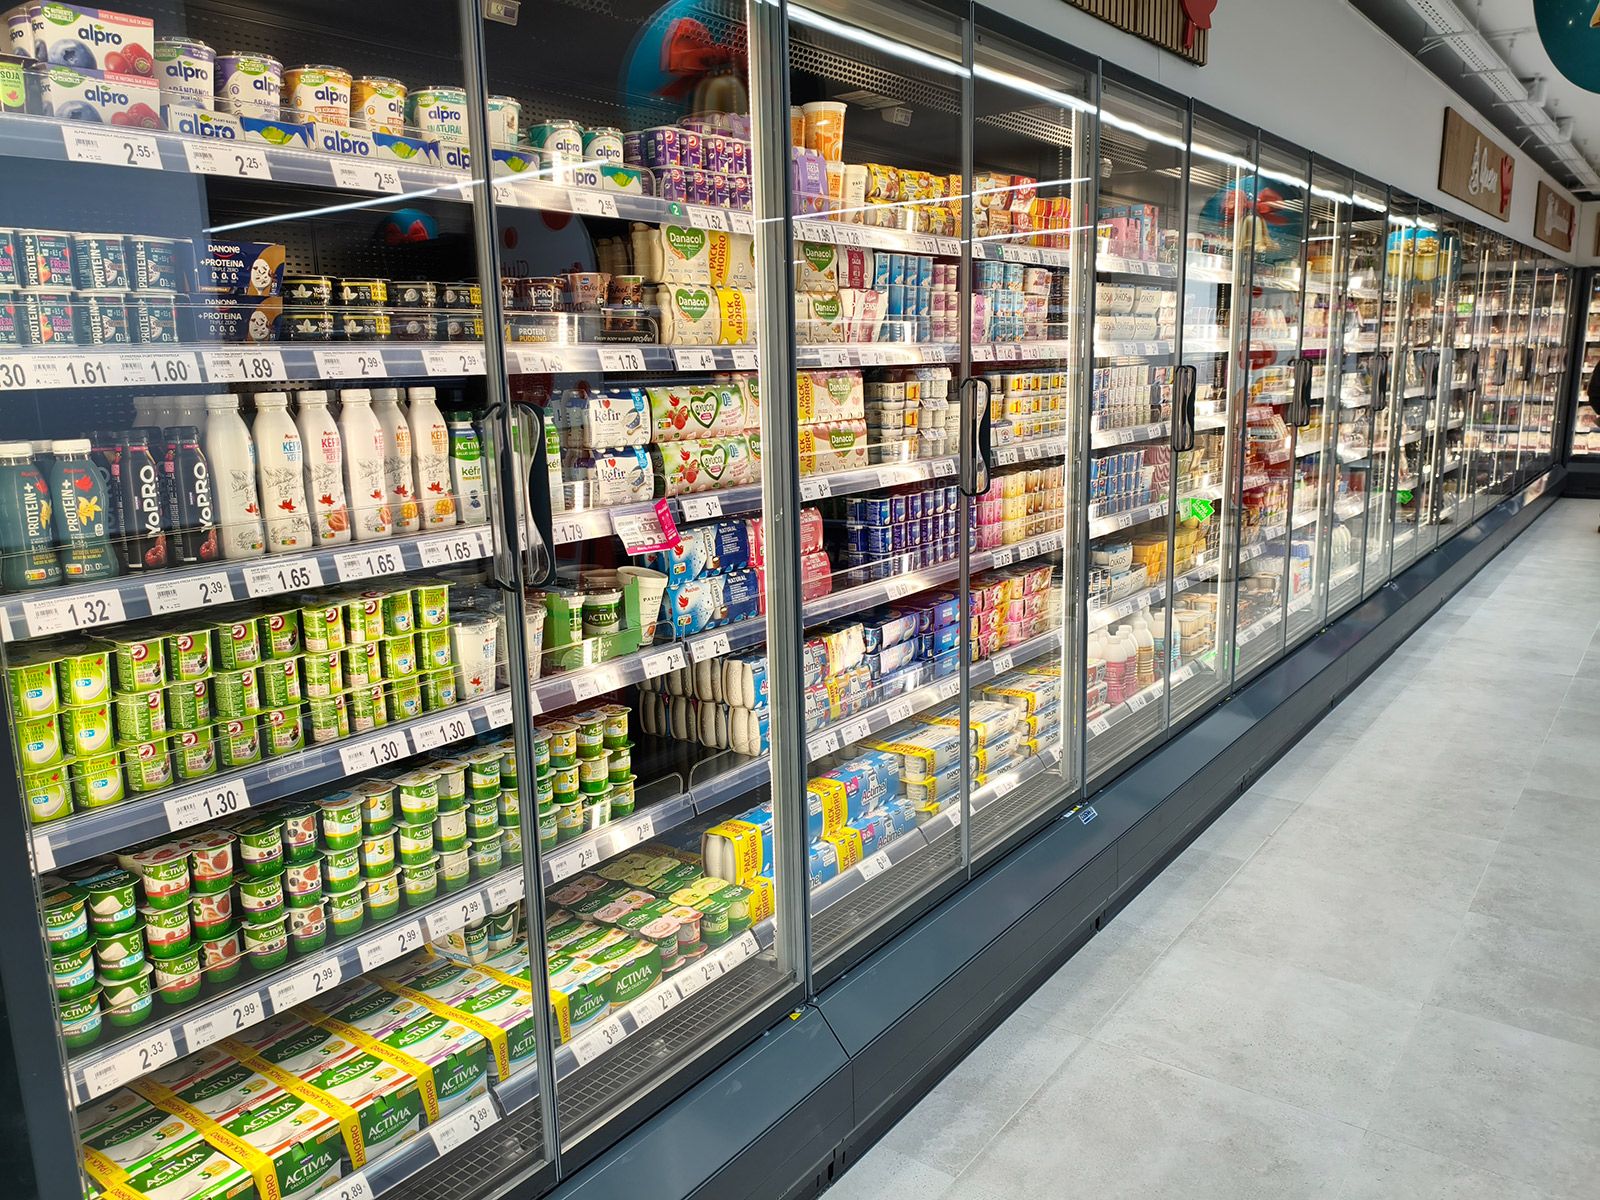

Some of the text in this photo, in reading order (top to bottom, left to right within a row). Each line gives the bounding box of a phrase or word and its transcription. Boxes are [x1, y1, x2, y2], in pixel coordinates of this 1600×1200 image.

[78, 24, 122, 46] alpro
[1, 71, 20, 80] SOJA
[166, 61, 208, 81] alpro
[85, 85, 128, 107] alpro
[315, 87, 347, 105] alpro
[429, 106, 460, 122] alpro
[179, 113, 235, 139] alpro
[324, 131, 369, 156] alpro
[556, 140, 580, 153] alpro
[596, 146, 620, 160] alpro
[705, 215, 722, 229] 1.52
[669, 233, 701, 244] Danacol
[709, 243, 718, 269] PACK
[717, 235, 726, 279] AHORRO
[805, 248, 832, 258] Danacol
[677, 295, 707, 309] Danacol
[815, 303, 837, 313] Danacol
[734, 292, 742, 337] AHORRO
[239, 358, 272, 378] 1.89
[619, 355, 638, 370] 1.78
[595, 407, 621, 423] kéfir
[831, 434, 853, 444] Danacol
[600, 467, 626, 481] kéfir
[140, 464, 162, 538] YoPRO
[193, 461, 213, 532] YoPRO
[561, 524, 583, 544] 1.79
[445, 541, 470, 562] 1.65
[366, 553, 395, 575] 1.65
[277, 567, 311, 590] 1.65
[68, 599, 110, 626] 1.32
[588, 614, 617, 622] ACTIVIA
[440, 720, 465, 742] 1.30
[370, 740, 398, 765] 1.30
[862, 779, 887, 803] Actimel
[203, 791, 238, 817] 1.30
[615, 965, 652, 993] ACTIVIA
[472, 989, 512, 1011] ACTIVIA
[574, 995, 604, 1019] ACTIVIA
[398, 1019, 443, 1046] ACTIVIA
[499, 1042, 507, 1076] AHORRO
[326, 1060, 374, 1086] ACTIVIA
[441, 1065, 479, 1093] ACTIVIA
[426, 1080, 437, 1116] AHORRO
[243, 1101, 296, 1132] ACTIVIA
[368, 1108, 411, 1139] ACTIVIA
[351, 1125, 365, 1162] AHORRO
[146, 1152, 205, 1188] ACTIVIA
[285, 1153, 332, 1188] ACTIVIA
